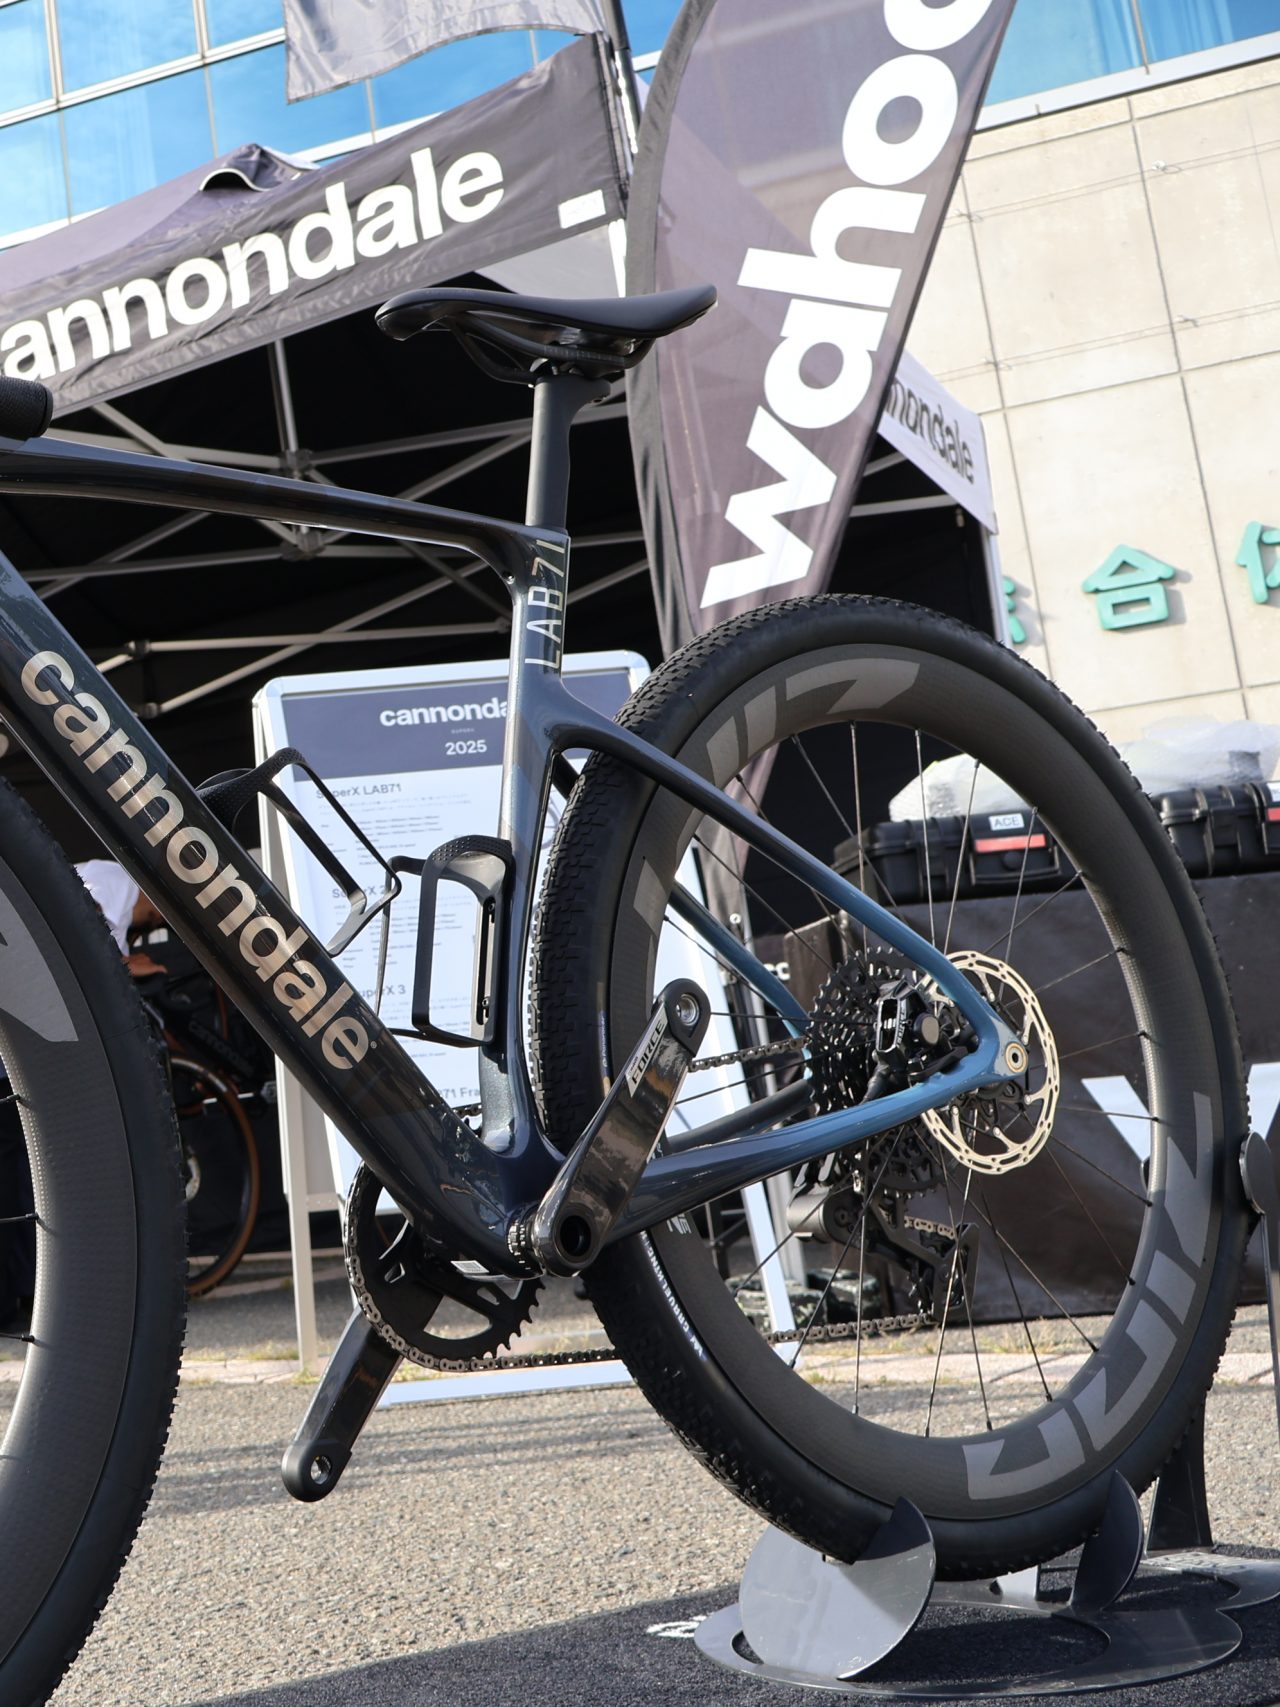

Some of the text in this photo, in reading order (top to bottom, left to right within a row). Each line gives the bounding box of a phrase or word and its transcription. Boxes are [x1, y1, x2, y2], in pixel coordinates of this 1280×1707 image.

[525, 540, 565, 669] LAB71
[445, 739, 487, 755] 2025
[316, 783, 402, 799] SperX LAB71
[994, 815, 1021, 828] ACE
[22, 650, 369, 1070] cannondale
[398, 984, 406, 995] 3
[632, 1020, 665, 1085] FORCE
[963, 1090, 1212, 1500] ZIPP
